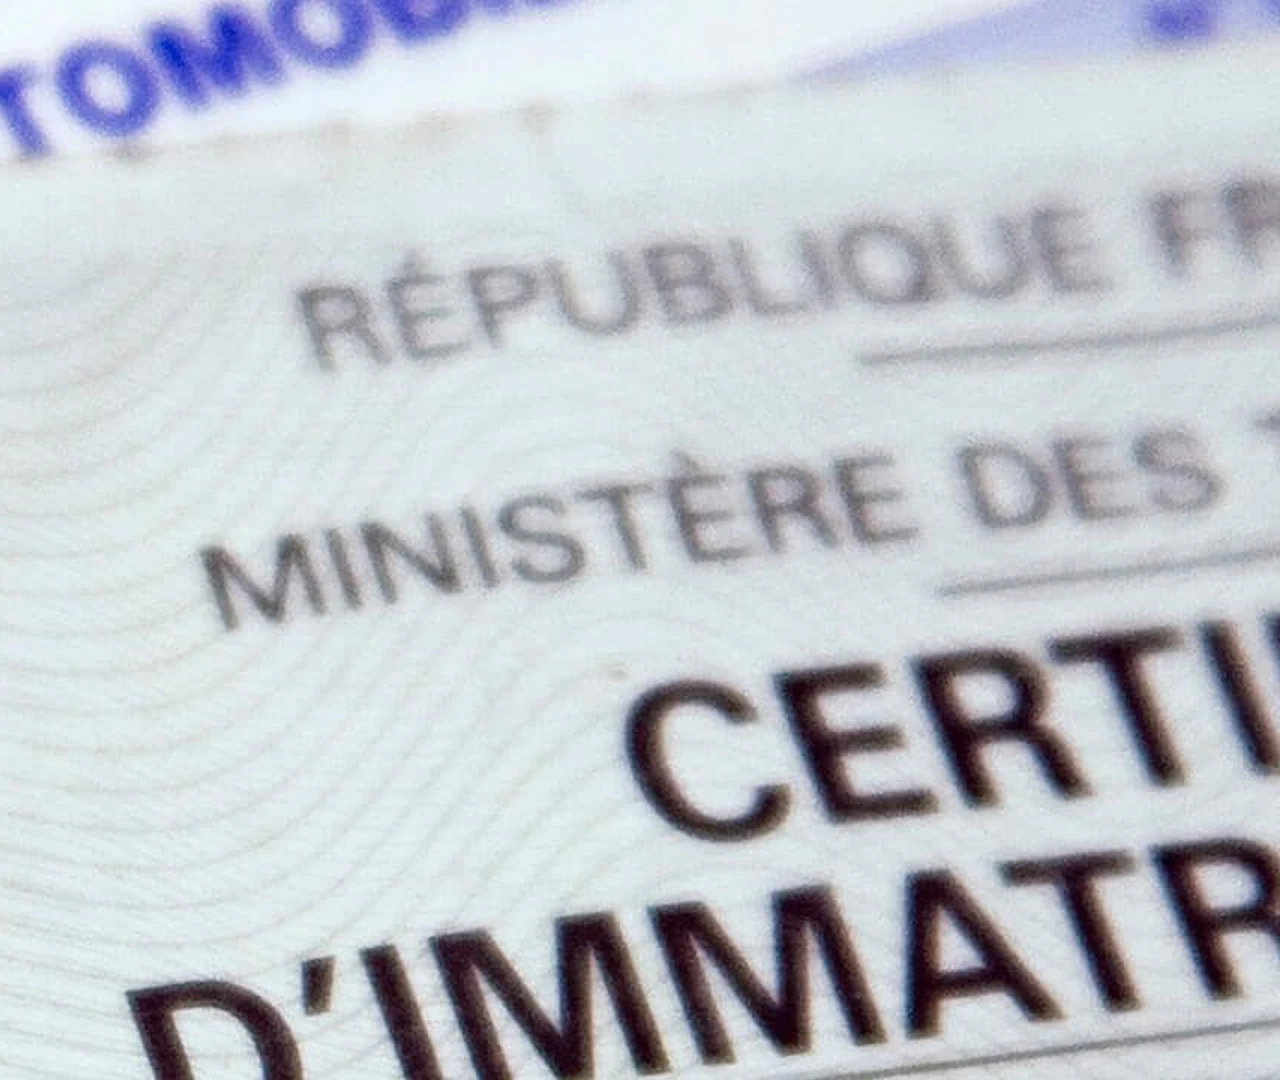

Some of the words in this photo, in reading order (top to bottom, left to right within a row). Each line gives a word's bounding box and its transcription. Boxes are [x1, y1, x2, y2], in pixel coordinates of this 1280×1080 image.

[292, 200, 1112, 376] RÉPUBLIQUE
[198, 445, 920, 632] MINISTÈRE
[952, 424, 1228, 534] DES
[622, 608, 1280, 845] CERTI
